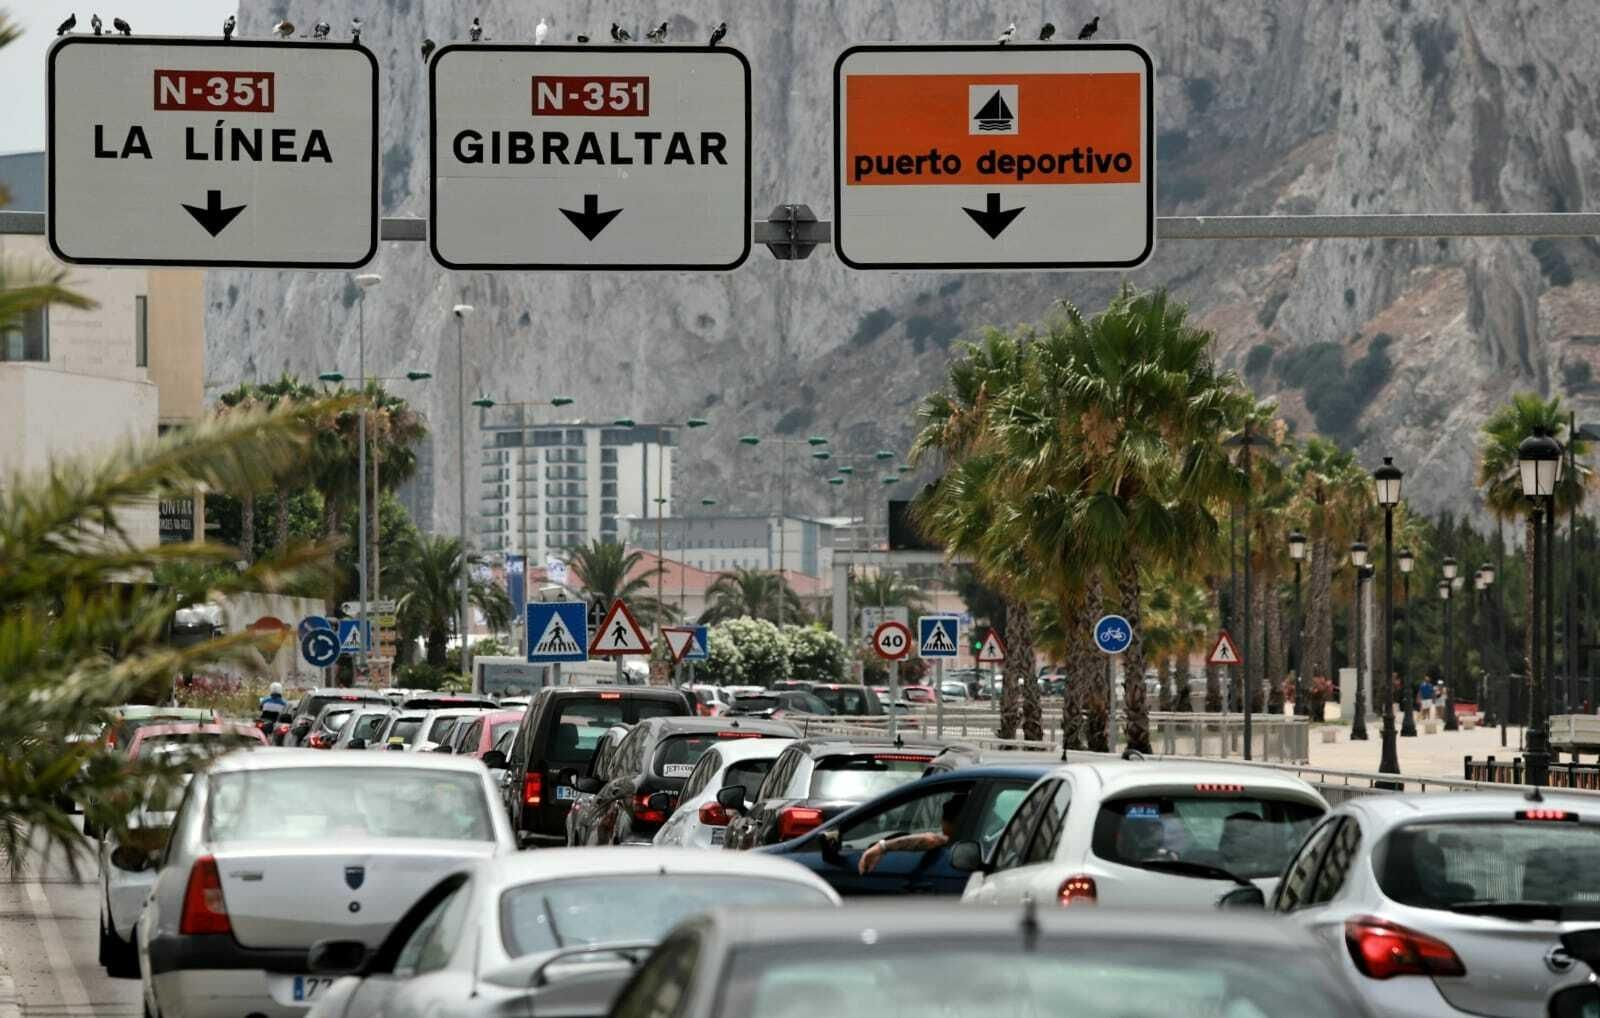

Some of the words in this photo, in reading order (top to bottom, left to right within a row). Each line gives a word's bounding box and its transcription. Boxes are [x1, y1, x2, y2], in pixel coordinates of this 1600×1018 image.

[160, 76, 269, 106] N-351
[537, 82, 644, 110] N-351
[94, 124, 153, 160] LA
[185, 119, 333, 163] LÍNEA
[452, 129, 728, 166] GIBRALTAR
[854, 148, 962, 181] puerto
[976, 147, 1133, 182] deportivo
[881, 635, 904, 647] 40
